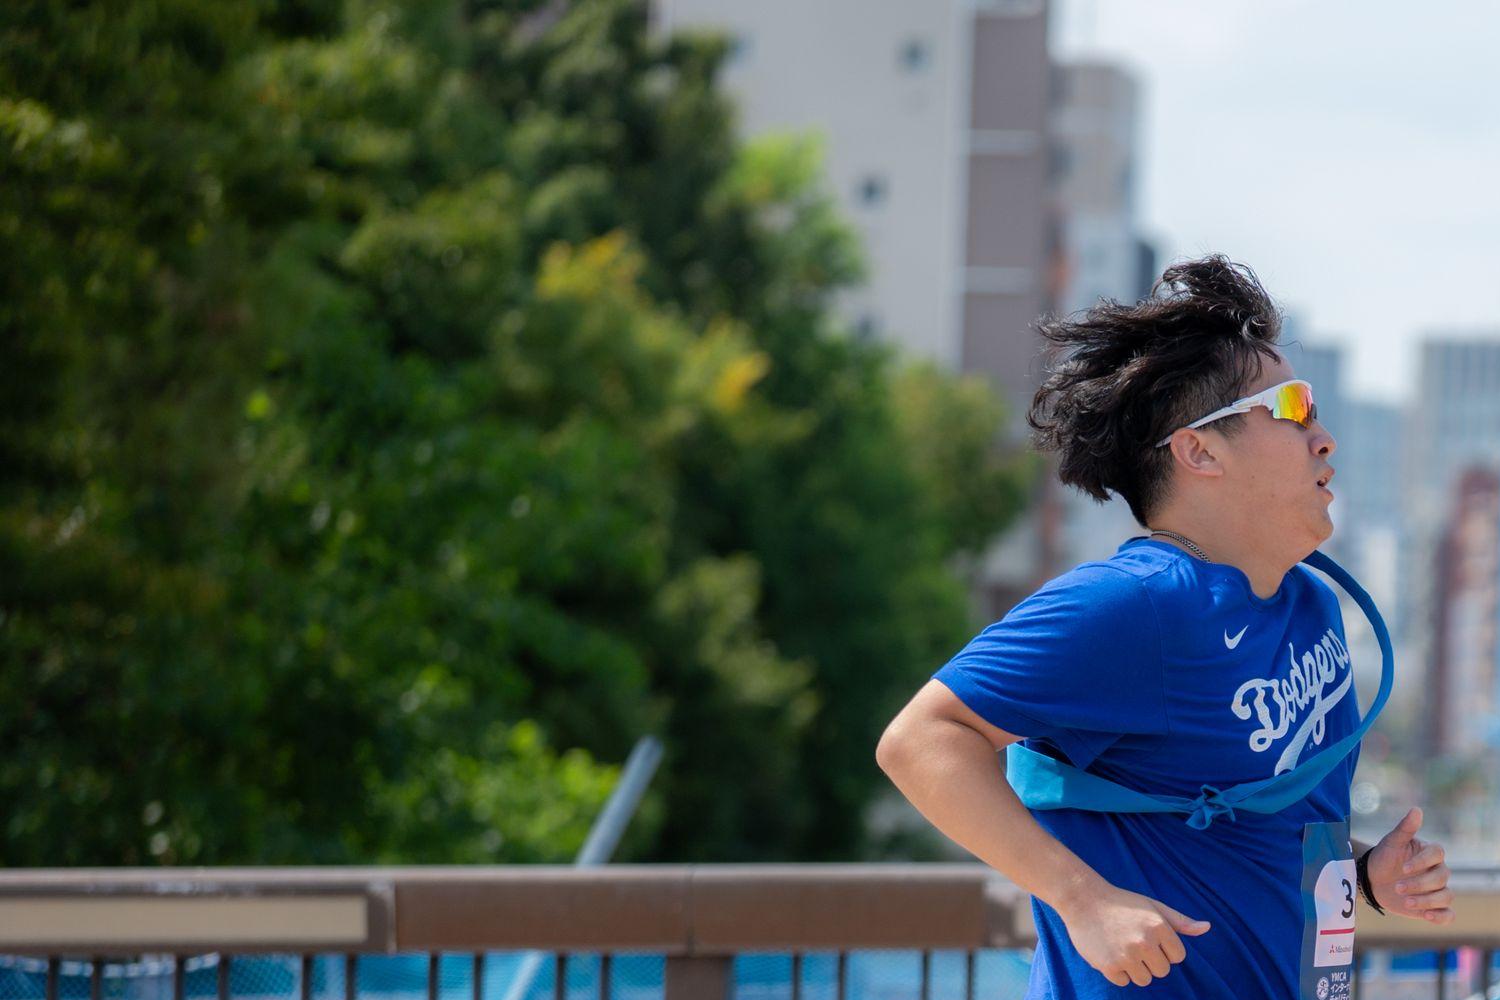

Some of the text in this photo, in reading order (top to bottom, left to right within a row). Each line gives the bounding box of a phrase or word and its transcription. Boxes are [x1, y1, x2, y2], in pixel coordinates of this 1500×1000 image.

[1231, 627, 1351, 776] Dodgers
[1341, 878, 1354, 919] 3
[1331, 971, 1347, 982] YMCA
